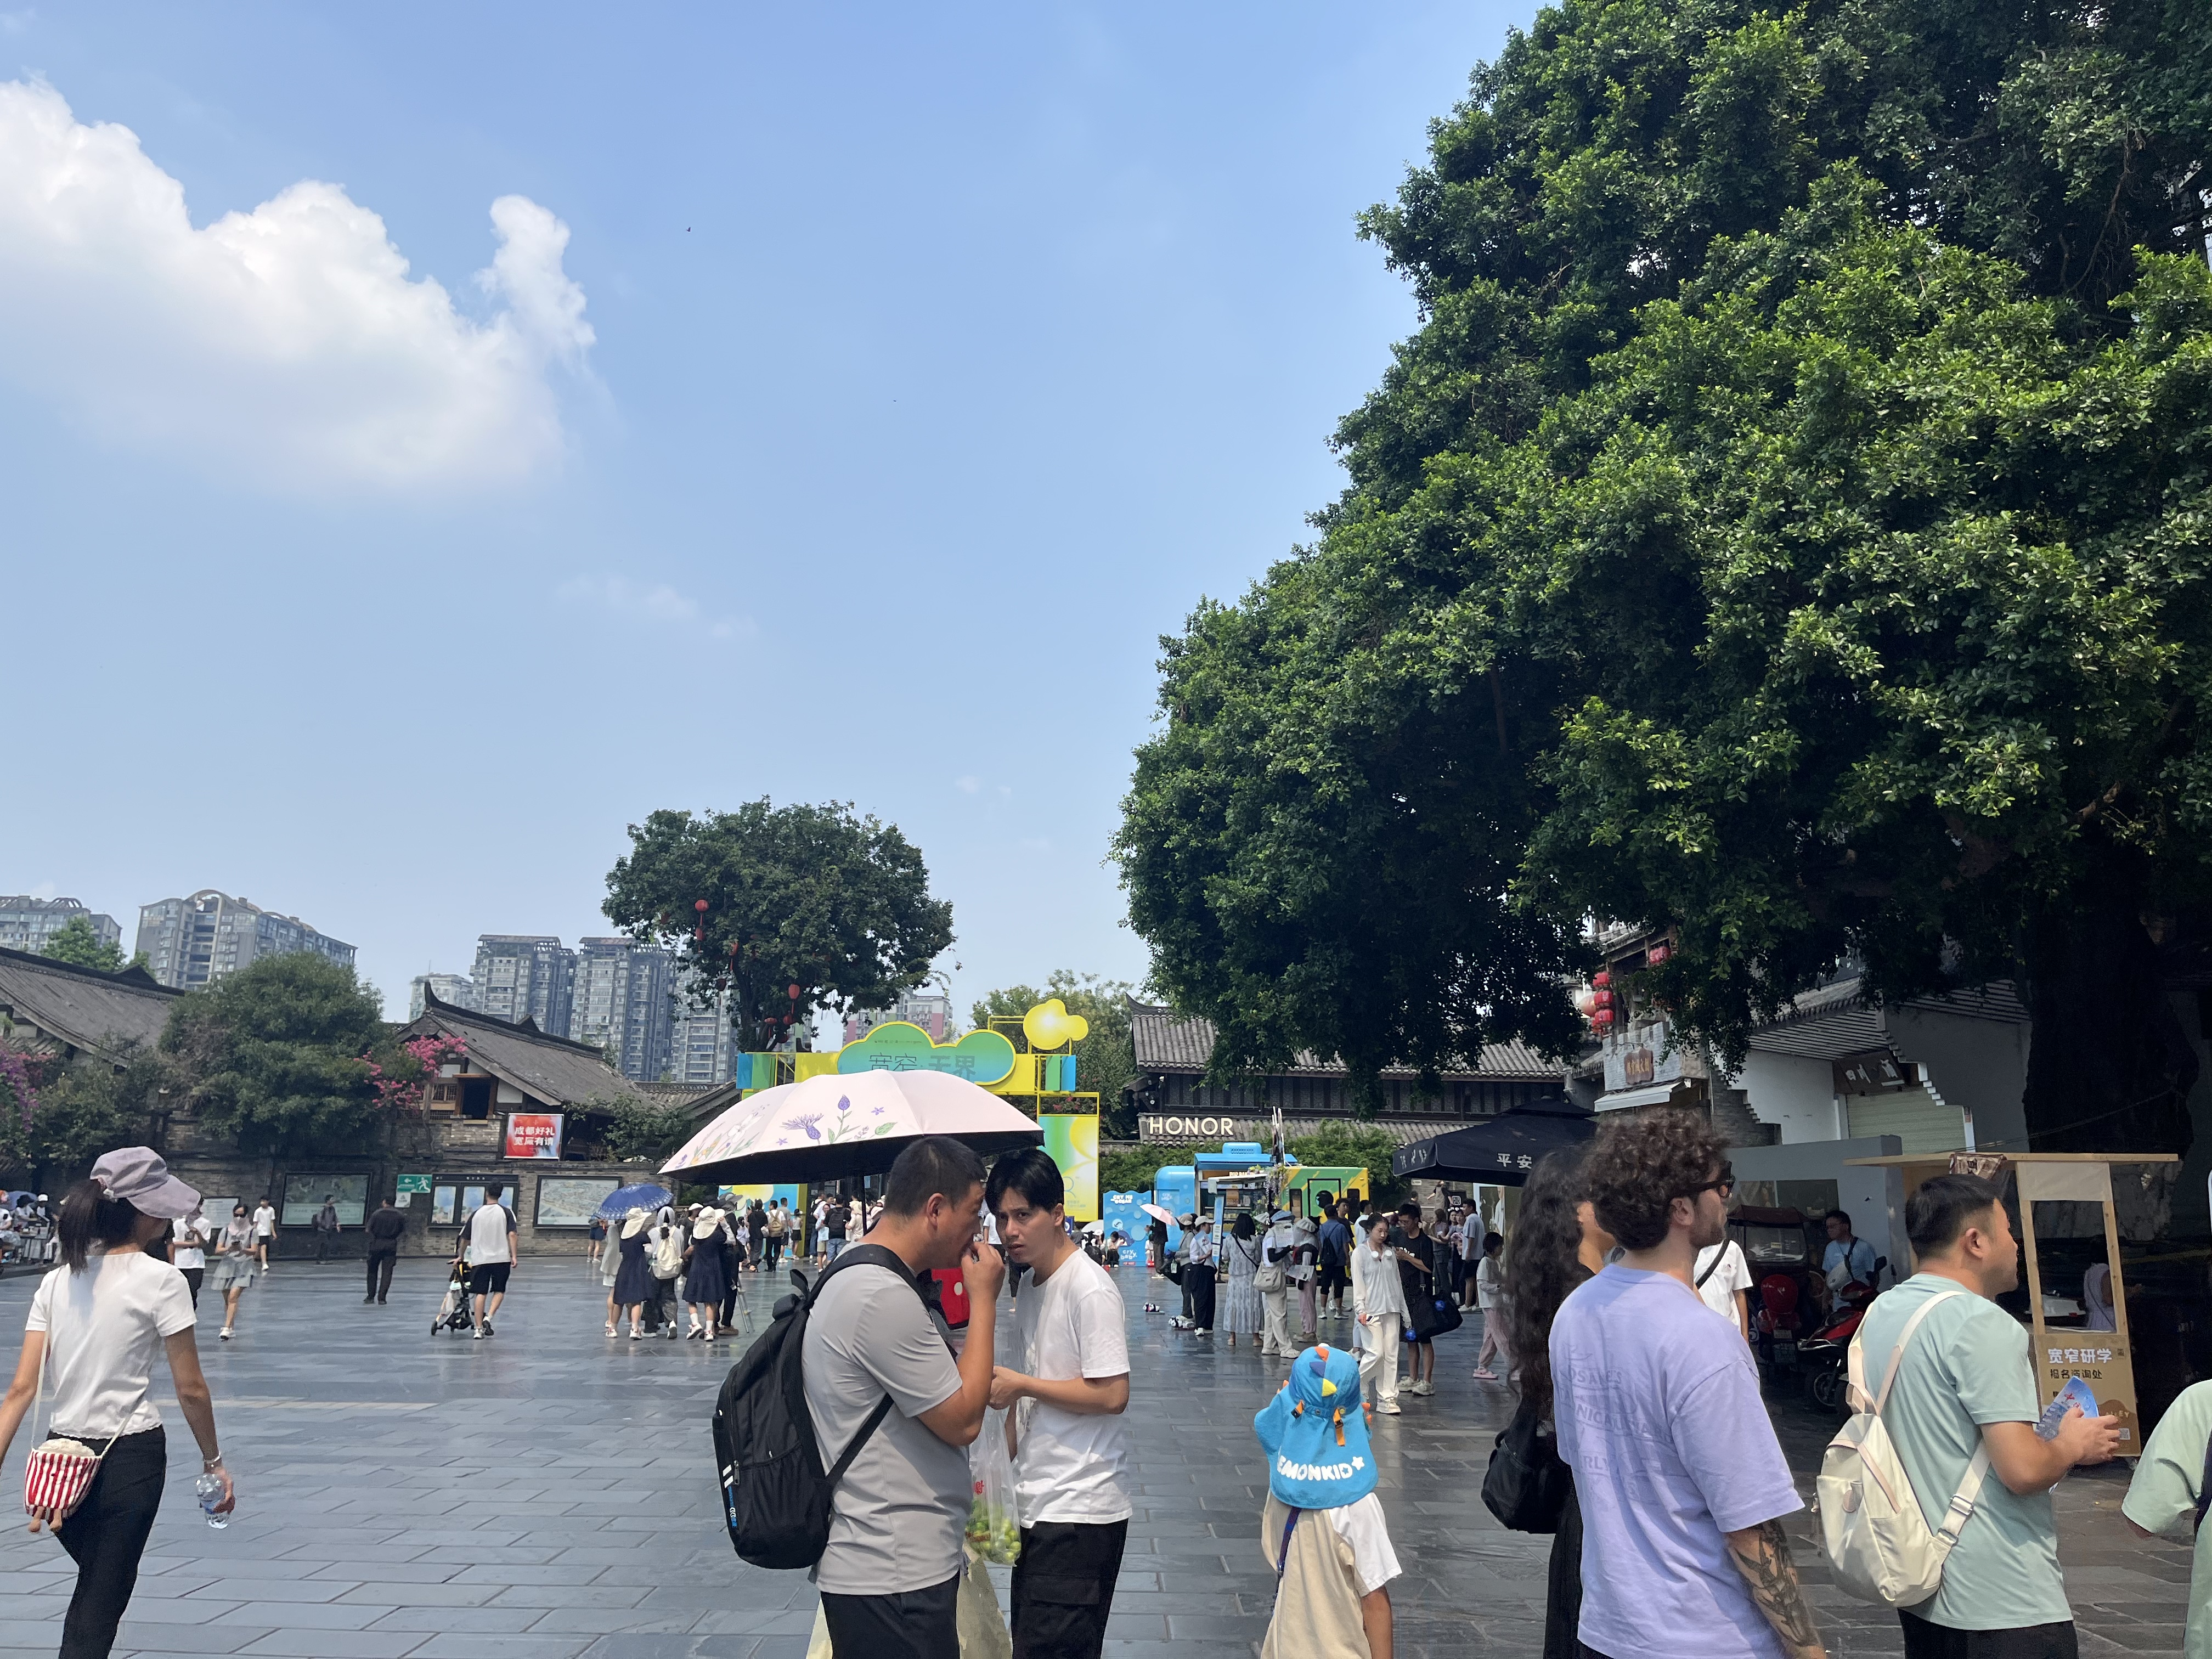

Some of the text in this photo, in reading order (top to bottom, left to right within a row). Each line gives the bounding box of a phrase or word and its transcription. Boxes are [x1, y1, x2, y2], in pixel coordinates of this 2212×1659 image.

[515, 1126, 555, 1136] 成都好礼
[1149, 1116, 1234, 1135] HONOR
[2047, 1348, 2112, 1364] 宽窄研学
[2050, 1369, 2103, 1379] 报名咨询处
